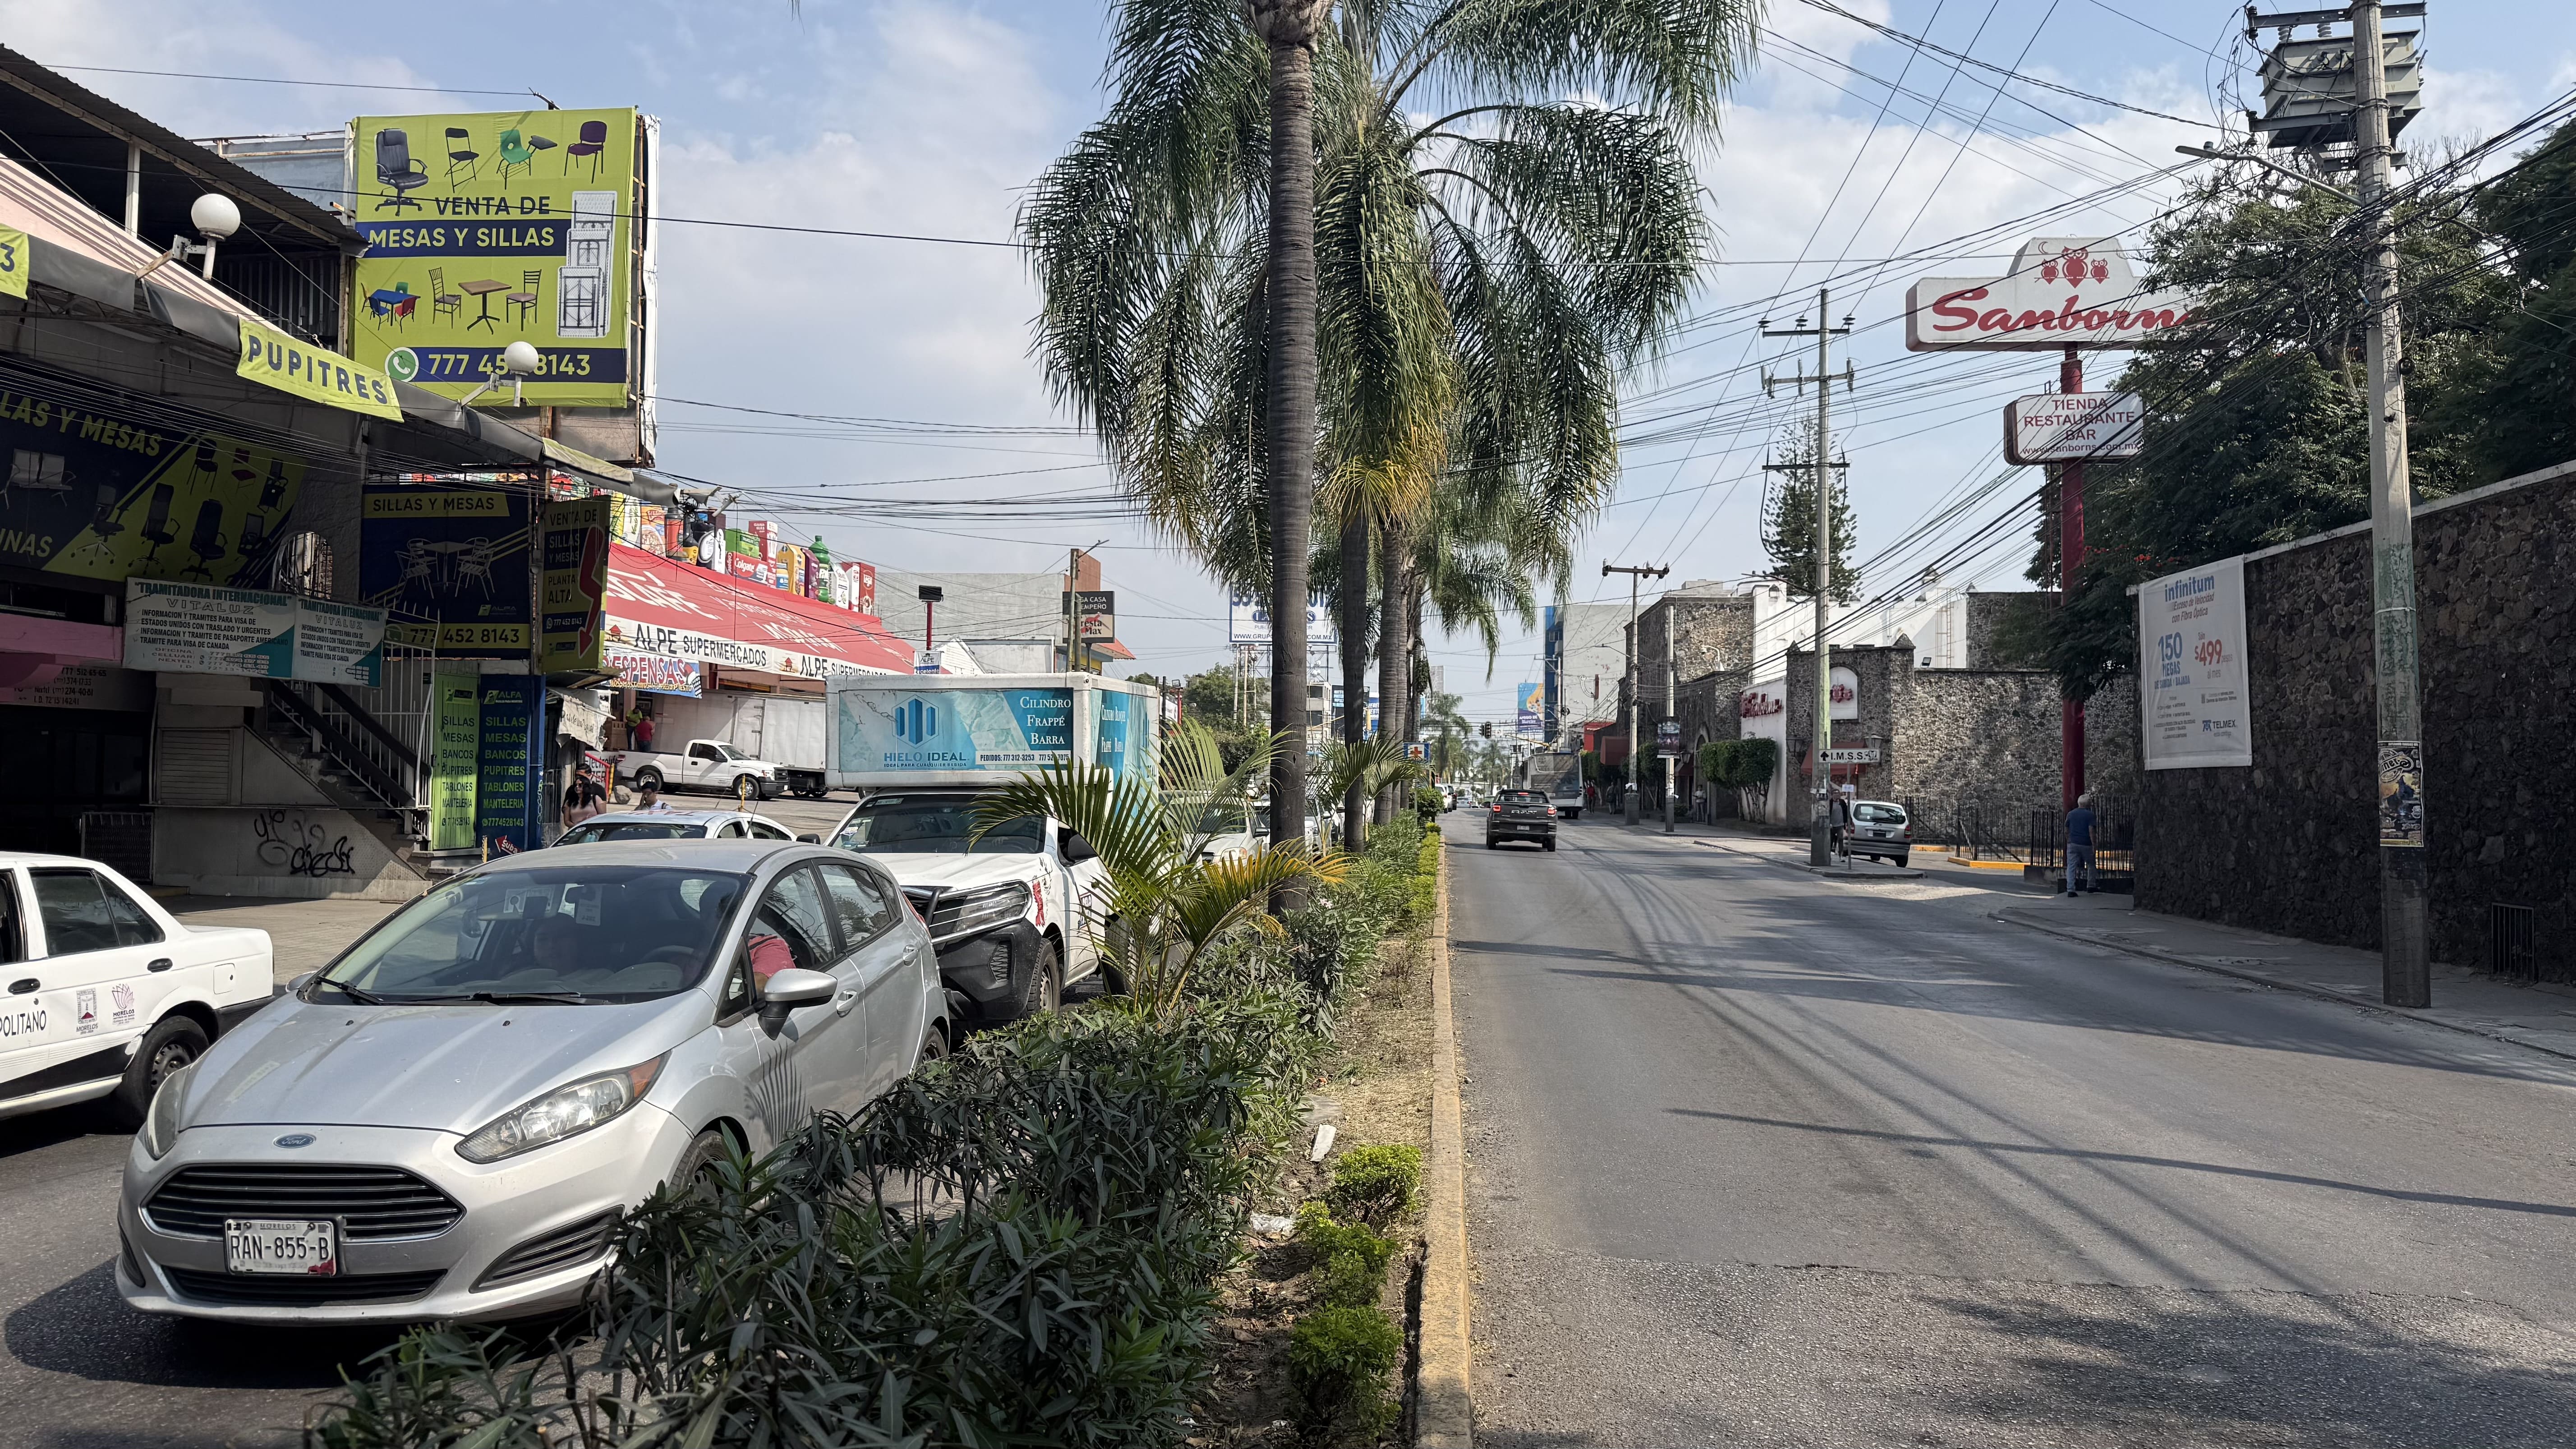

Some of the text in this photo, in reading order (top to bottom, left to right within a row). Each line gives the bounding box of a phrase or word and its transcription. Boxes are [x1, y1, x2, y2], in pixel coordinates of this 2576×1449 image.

[435, 196, 550, 216] VENTA DE
[369, 227, 555, 248] MESAS Y SILLAS
[248, 335, 388, 405] PUPITRES
[428, 354, 591, 375] 777 45 8143
[2052, 398, 2107, 411] TIENDA
[2024, 412, 2134, 427] RESTAURANTE
[59, 407, 77, 433] Y
[79, 414, 162, 456] MESAS
[2065, 429, 2096, 440] BAR
[373, 497, 494, 511] SILLAS Y MESAS
[550, 509, 597, 526] VENTA DE
[550, 534, 580, 549] SILLAS
[549, 551, 579, 563] Y MESAS
[734, 558, 755, 573] Colgate
[548, 575, 576, 585] PLANTA
[2165, 575, 2214, 602] infinitum
[548, 589, 572, 604] ALTA
[2174, 592, 2214, 611] Exceso de Velocidad
[166, 598, 253, 614] VITALUZ
[142, 609, 182, 619] INFORMACION
[189, 613, 217, 622] TRAMITES
[218, 615, 233, 623] PARA
[234, 616, 247, 624] VISA
[2181, 611, 2192, 621] Fibra
[141, 618, 167, 626] ESTADOS
[206, 624, 235, 632] TRASLADO
[241, 626, 271, 635] URGENTES
[316, 615, 362, 630] VITALUZ
[140, 637, 165, 645] TRAMITE
[141, 628, 181, 637] INFORMACION
[188, 631, 212, 639] TRAMITE
[223, 634, 254, 642] PASAPORTE
[410, 629, 520, 643] 777 452 8143
[634, 624, 677, 655] ALPE
[683, 635, 766, 667] SUPERMERCADOS
[2158, 632, 2183, 662] 150
[2194, 639, 2222, 666] $499
[800, 655, 828, 677] ALPE
[1020, 696, 1071, 708] CILINDRO
[443, 716, 474, 727] SILLAS
[486, 717, 527, 727] SILLAS
[1027, 715, 1065, 727] FRAPPÉ
[2213, 720, 2236, 729] TELMEX
[443, 732, 474, 743] MESAS
[485, 733, 527, 743] MESAS
[1030, 732, 1065, 744] BARRA
[442, 749, 474, 759] BANCOS
[485, 750, 526, 759] BANCOS
[884, 752, 967, 762] HIELO IDEAL
[1831, 752, 1866, 760] I.M.S.S.
[442, 766, 472, 775] PUPITRES
[484, 766, 525, 776] PUPITRES
[442, 782, 473, 791] TABLONES
[484, 782, 524, 791] TABLONES
[442, 798, 472, 808] MANTELERIA
[483, 799, 524, 808] MANTELERIA
[488, 818, 524, 826] 7774528143
[113, 1009, 135, 1017] MORELOS
[76, 1023, 98, 1032] MORELOS
[230, 1235, 329, 1260] RAN-855-B
